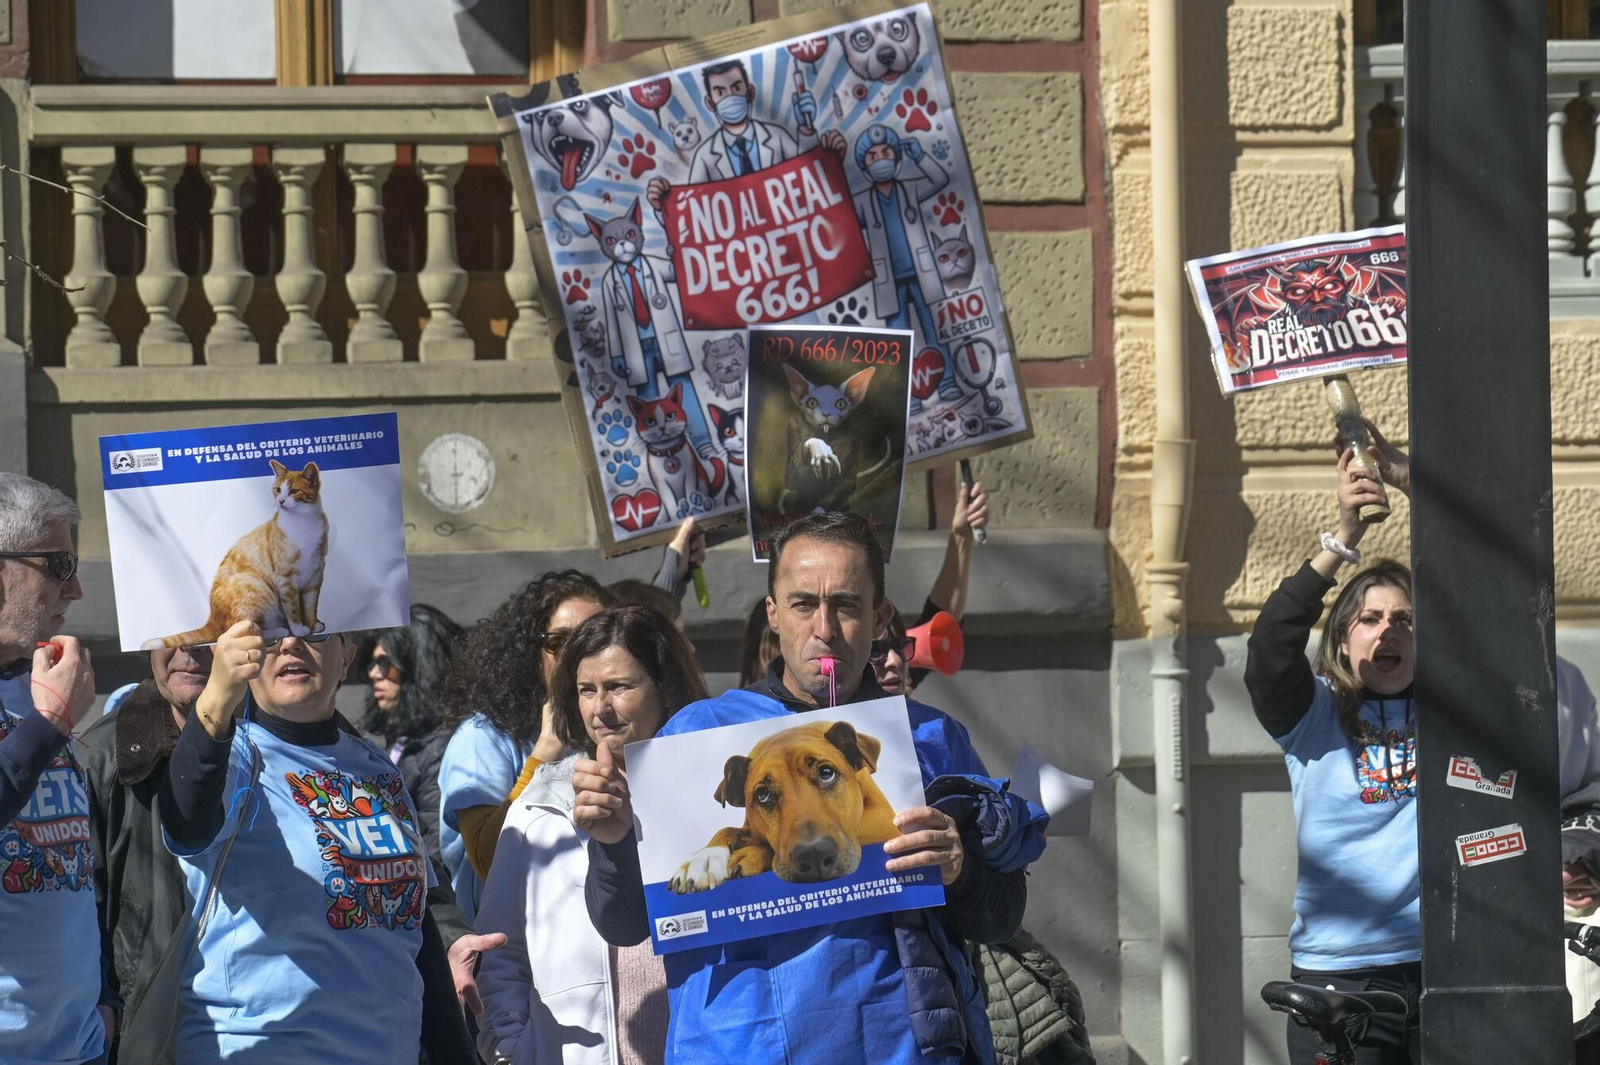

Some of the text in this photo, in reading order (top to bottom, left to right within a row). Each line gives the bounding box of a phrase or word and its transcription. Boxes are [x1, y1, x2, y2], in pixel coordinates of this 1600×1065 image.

[739, 188, 767, 231] AL
[764, 159, 843, 226] REAL
[681, 214, 844, 296] DECRETO
[1242, 258, 1270, 269] animales
[1370, 251, 1400, 265] 666
[735, 267, 822, 323] 666!
[939, 329, 951, 339] AL
[1250, 302, 1407, 368] DECRETO 66
[1267, 314, 1304, 335] REAL
[762, 336, 901, 366] RD 666/2023
[167, 449, 182, 457] EN
[184, 444, 234, 456] DEFENSA
[236, 442, 257, 451] DEL
[259, 437, 311, 449] CRITERIO
[313, 430, 384, 444] VETERINARIO
[194, 441, 363, 464] Y LA SALUD DE LOS ANIMALES
[31, 819, 90, 843] UNIDOS
[1459, 830, 1495, 844] Granada
[360, 859, 425, 882] UNIDOS
[711, 873, 924, 919] EN DEFENSA DEL CRITERIO VETERINARIO
[738, 884, 903, 922] Y LA SALUD DE LOS ANIMALES
